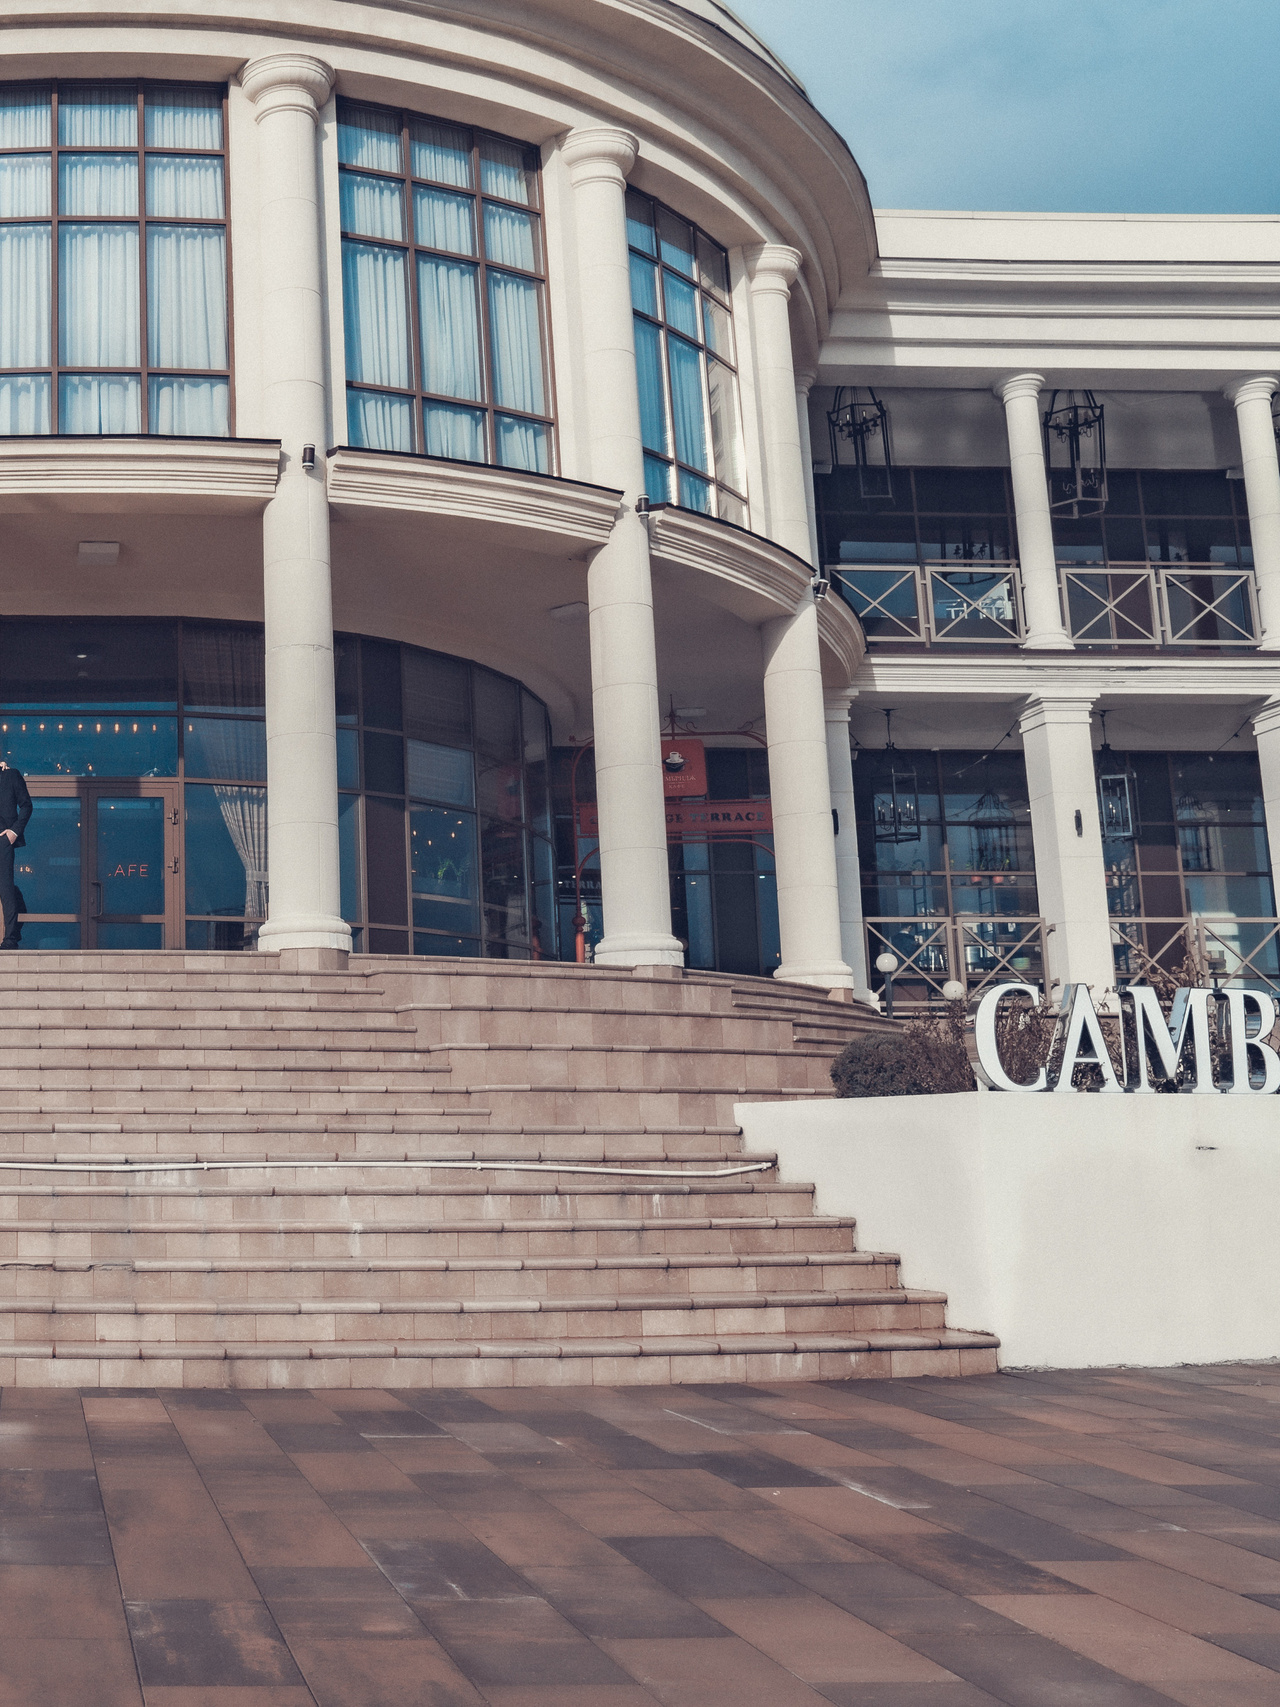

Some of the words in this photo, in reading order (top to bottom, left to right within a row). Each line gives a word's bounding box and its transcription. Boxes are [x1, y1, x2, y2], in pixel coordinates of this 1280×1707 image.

[688, 811, 766, 822] TERRACE
[108, 864, 149, 877] AFE
[975, 983, 1280, 1094] CAMB
